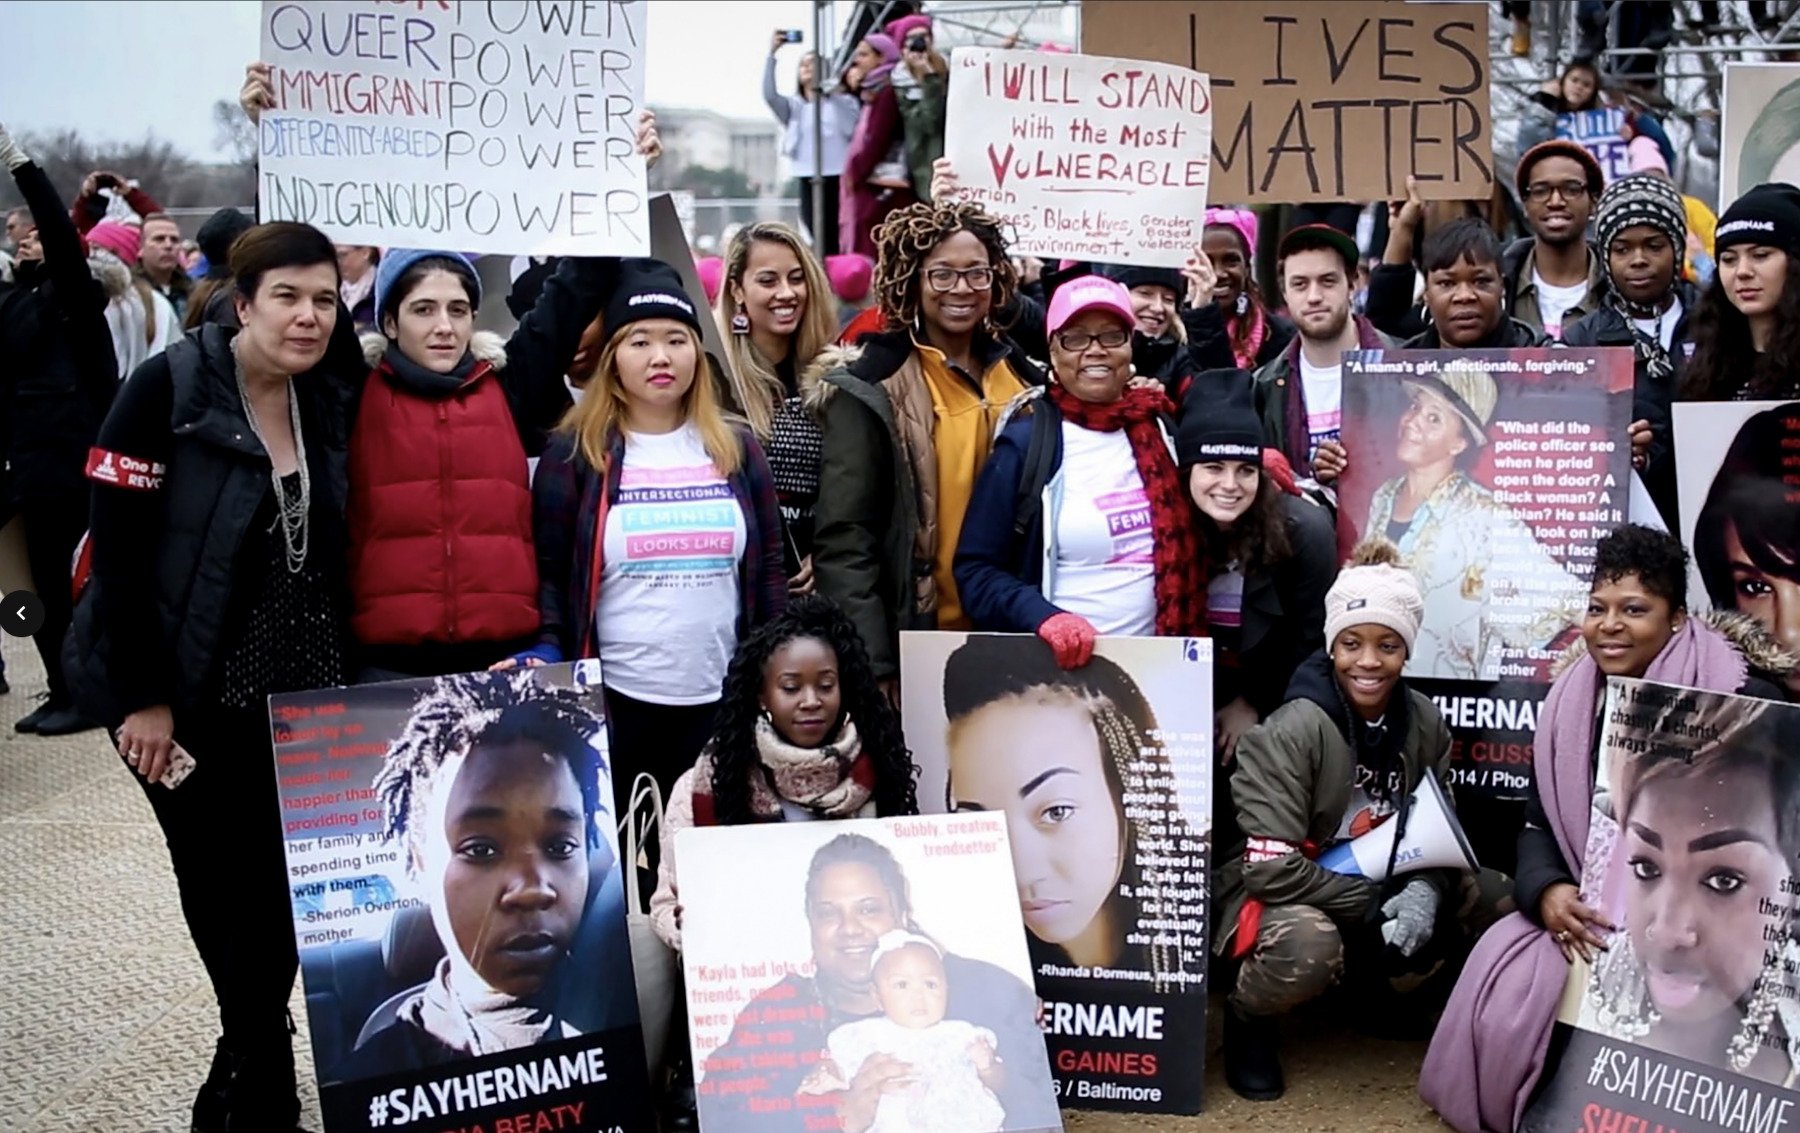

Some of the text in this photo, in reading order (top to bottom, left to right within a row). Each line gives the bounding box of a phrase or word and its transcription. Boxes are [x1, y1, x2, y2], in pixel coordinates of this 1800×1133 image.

[270, 4, 632, 92] QUEER POWER
[1189, 13, 1483, 95] LIVES
[1003, 62, 1210, 114] WILL STAND
[448, 81, 636, 138] POWER
[1069, 118, 1107, 144] the
[1119, 121, 1187, 148] Most
[445, 130, 636, 178] POWER
[1211, 97, 1493, 196] MATTER
[987, 142, 1208, 190] VULNERABLE
[265, 172, 642, 244] INDIGENOUS POWER
[1044, 208, 1092, 230] Black
[1346, 359, 1595, 376] "A mama's girl, affectionate, forgiving."
[1495, 421, 1591, 435] "What did the
[1495, 439, 1616, 454] police officer see
[119, 456, 149, 473] One
[1493, 456, 1594, 472] when he pried
[1493, 473, 1616, 488] open the door? A
[620, 486, 730, 501] INTERSECTIONAL
[1492, 490, 1611, 504] Black woman? A
[1110, 509, 1151, 532] FEMI
[1554, 507, 1575, 521] He
[1578, 508, 1609, 522] said
[1611, 509, 1623, 522] it
[1534, 525, 1567, 539] look
[1568, 526, 1589, 539] on
[632, 536, 730, 554] LOOKS LIKE
[1567, 542, 1598, 557] face
[1487, 664, 1537, 677] mother
[1432, 695, 1545, 732] HERNA
[1606, 730, 1646, 754] always
[1140, 746, 1158, 757] an
[1128, 761, 1206, 773] who wanted
[1130, 776, 1206, 790] to enlighten
[284, 788, 377, 810] happier than
[1122, 792, 1206, 805] people about
[286, 807, 383, 832] providing for
[1124, 807, 1206, 823] things going
[1149, 822, 1205, 836] on in the
[289, 831, 395, 854] her family and
[1136, 838, 1206, 853] world. She
[290, 850, 399, 878] spending time
[1134, 853, 1206, 868] believed in
[1141, 868, 1206, 883] it, she felt
[293, 882, 327, 899] with
[1119, 883, 1206, 901] it, she fought
[302, 896, 423, 924] -Sherion Overton,
[1142, 900, 1206, 916] for it, and
[1758, 896, 1791, 921] they
[1136, 918, 1205, 934] eventually
[303, 927, 355, 944] mother
[1126, 930, 1205, 948] she died for
[741, 960, 768, 978] had
[770, 960, 796, 976] lots
[1037, 964, 1204, 984] -Rhanda Dormeus, mother
[693, 1013, 729, 1028] were
[1057, 1049, 1158, 1076] GAINES
[369, 1047, 608, 1128] #SAYHERNAME
[1077, 1080, 1162, 1102] Baltimore
[1587, 1045, 1796, 1133] #SAYHERNAME
